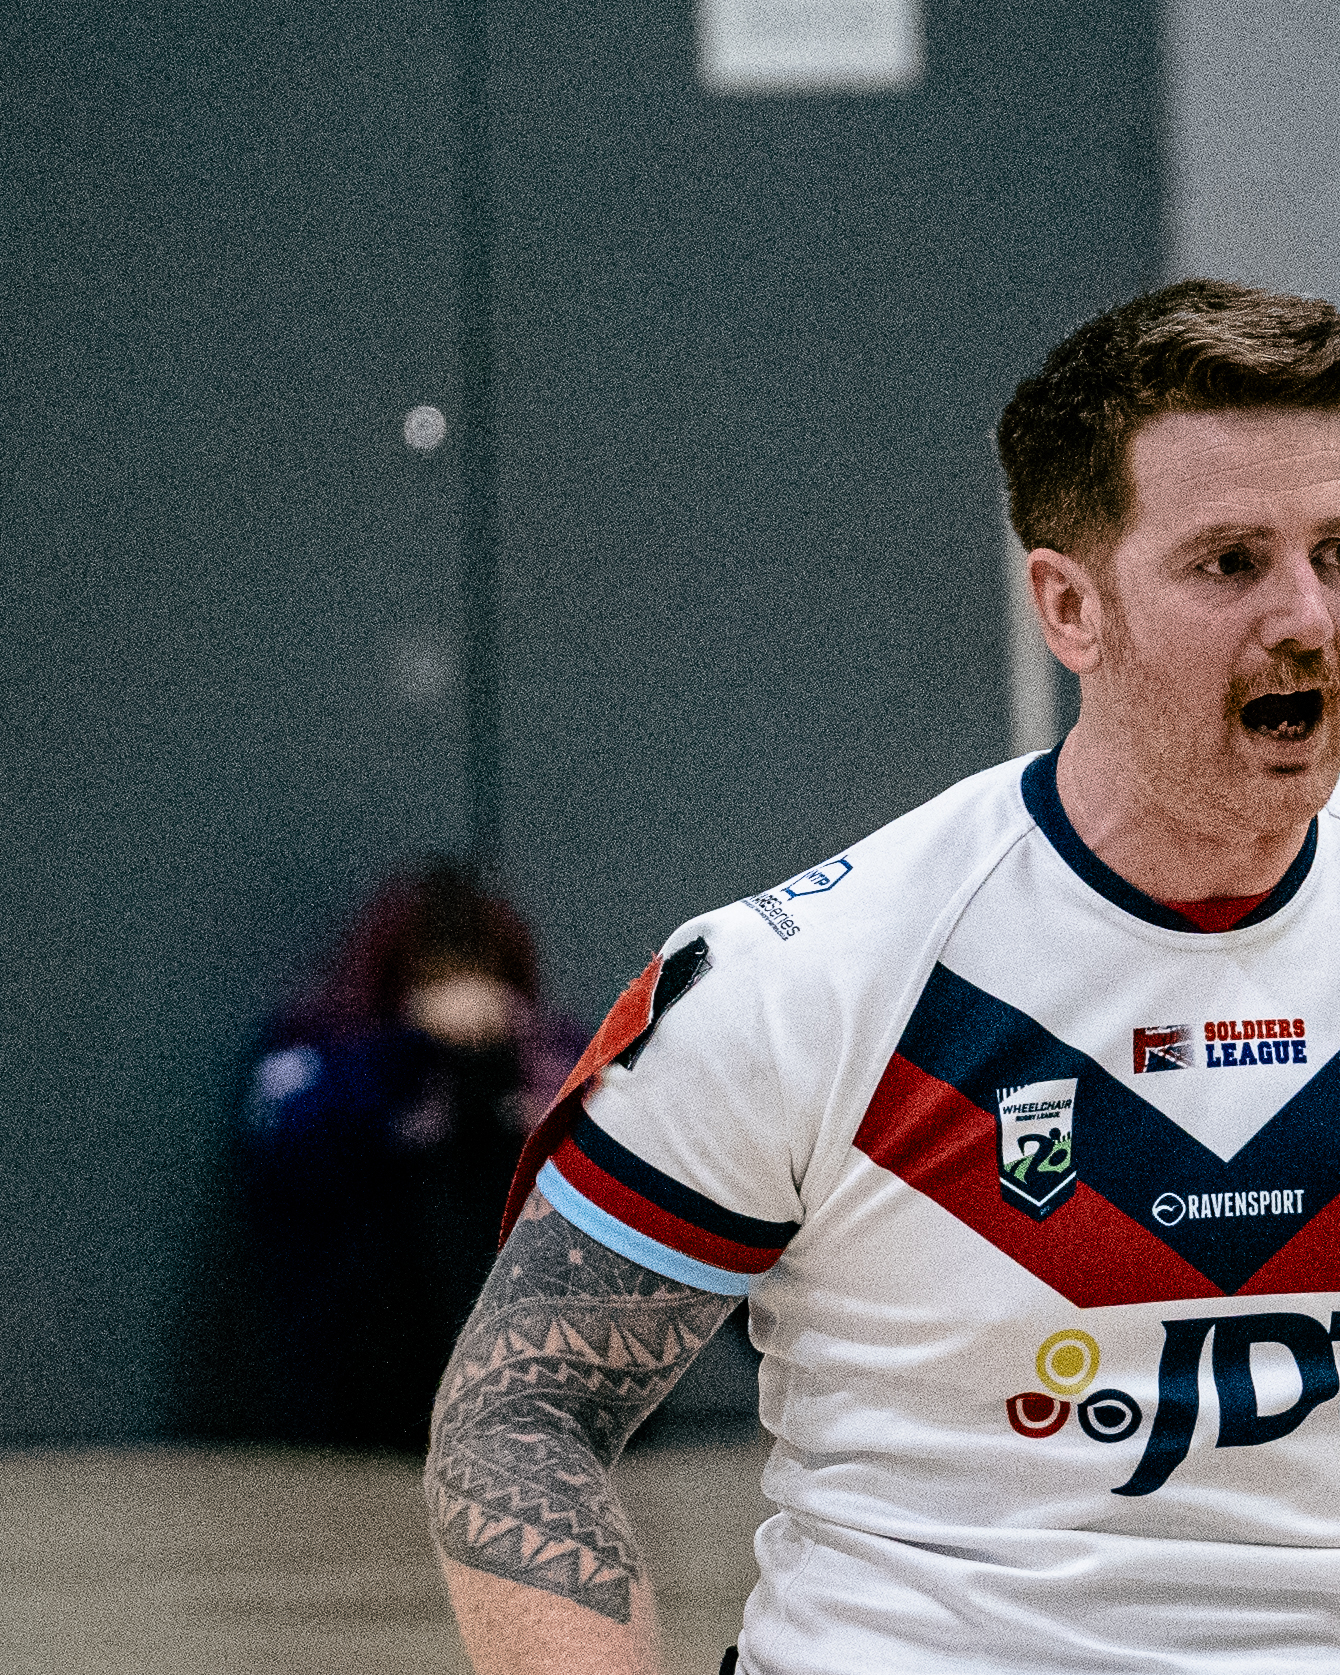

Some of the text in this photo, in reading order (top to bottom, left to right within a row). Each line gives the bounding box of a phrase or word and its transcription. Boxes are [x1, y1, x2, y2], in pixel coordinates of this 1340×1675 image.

[1203, 1018, 1306, 1042] SOLDIERS
[1205, 1039, 1308, 1068] LEAGUE
[1003, 1099, 1072, 1114] WHEELCHAIR
[1188, 1189, 1305, 1219] RAVENSPORT
